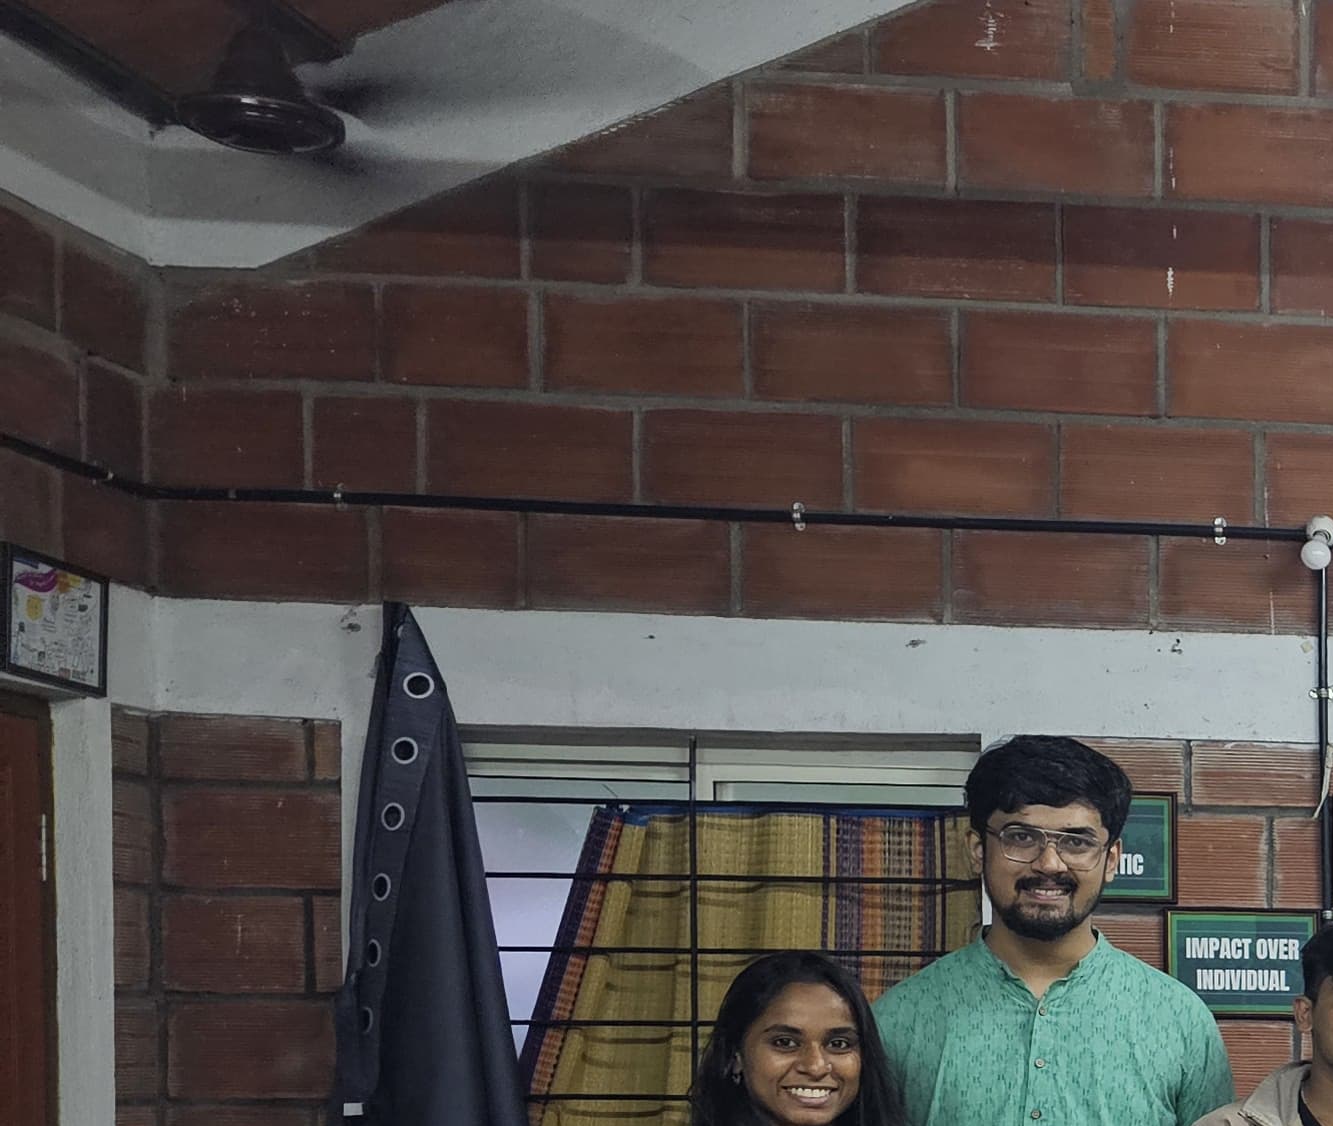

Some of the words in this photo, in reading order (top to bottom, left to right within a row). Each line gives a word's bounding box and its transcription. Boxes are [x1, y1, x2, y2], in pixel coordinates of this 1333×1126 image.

[1185, 937, 1251, 960] IMPACT
[1257, 938, 1300, 961] OVER
[1196, 968, 1290, 993] INDIVIDUAL
